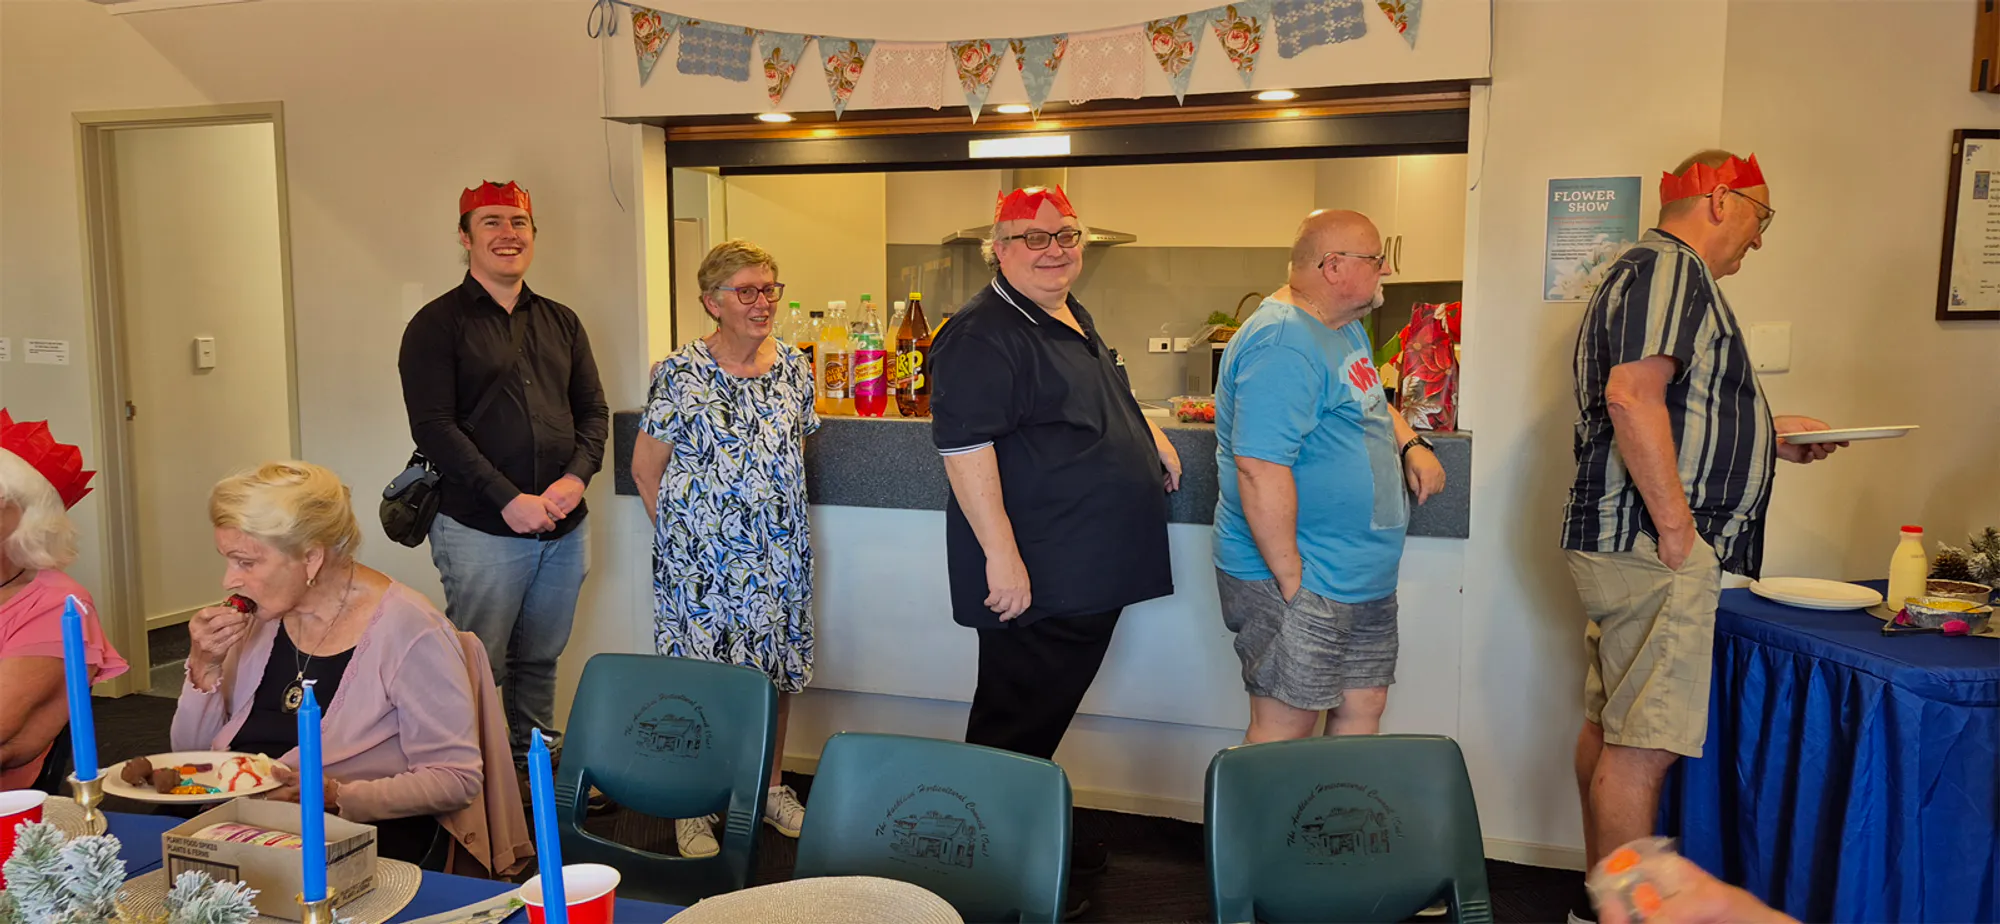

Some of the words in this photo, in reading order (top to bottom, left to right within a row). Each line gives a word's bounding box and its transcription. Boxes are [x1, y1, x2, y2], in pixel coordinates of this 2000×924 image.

[1553, 190, 1616, 202] FLOWER
[1568, 202, 1609, 213] SHOW
[875, 821, 888, 837] The
[886, 791, 915, 819] Auckland
[917, 783, 967, 802] Horticultural
[965, 802, 986, 830] Council
[167, 836, 183, 844] PLANT
[183, 839, 198, 847] FOOD
[1286, 830, 1296, 847] The
[167, 844, 186, 854] PLANTS
[192, 849, 209, 858] FERNS
